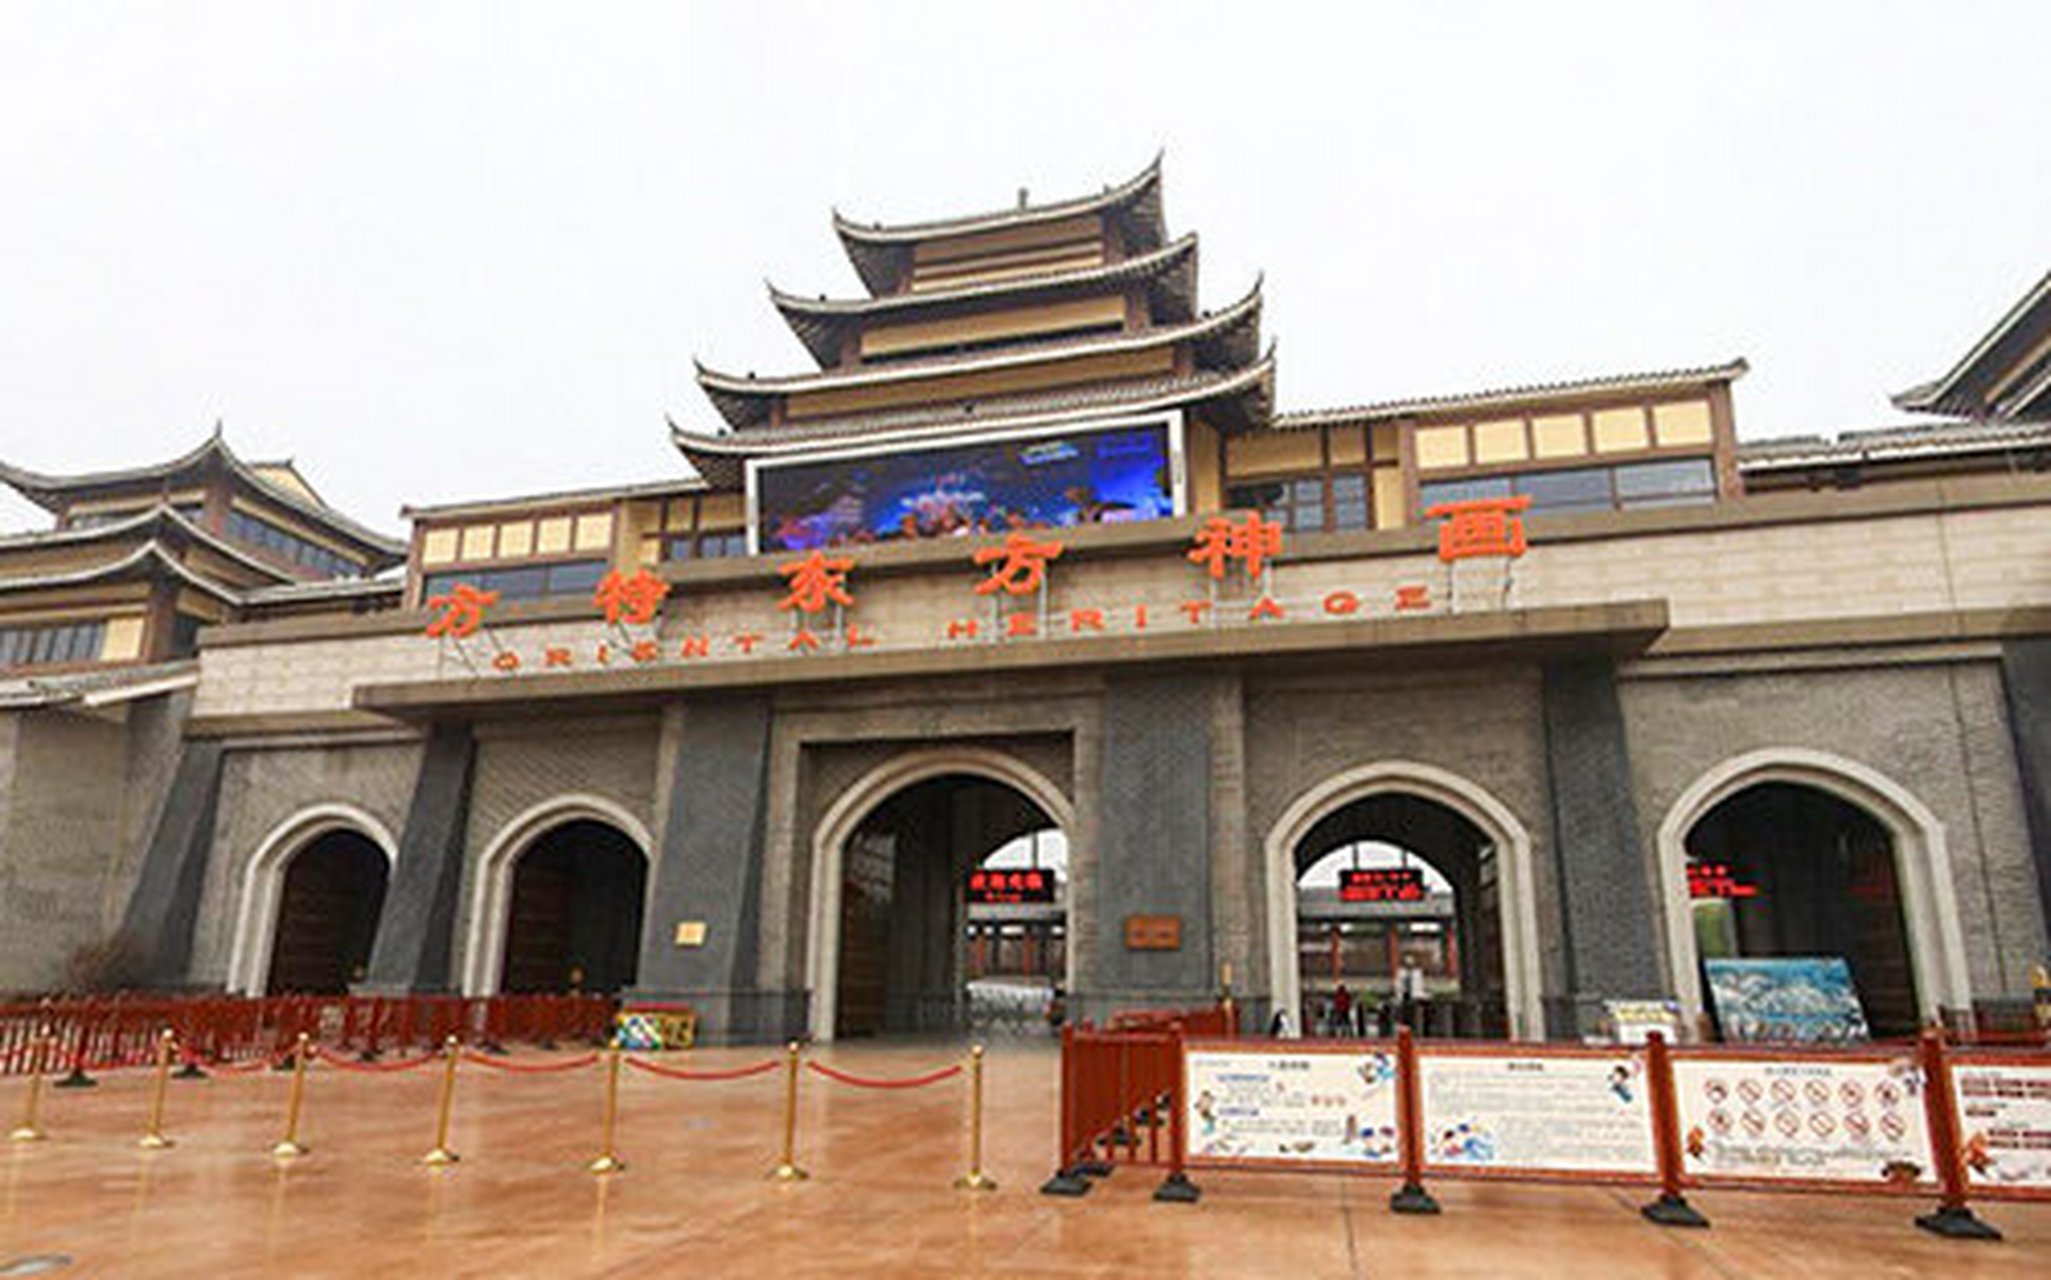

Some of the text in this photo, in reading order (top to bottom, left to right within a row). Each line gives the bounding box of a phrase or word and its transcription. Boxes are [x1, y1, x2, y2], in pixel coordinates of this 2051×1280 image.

[425, 495, 1532, 639] 方特东方神画
[493, 585, 1431, 669] ORIENTAL HERITAGE
